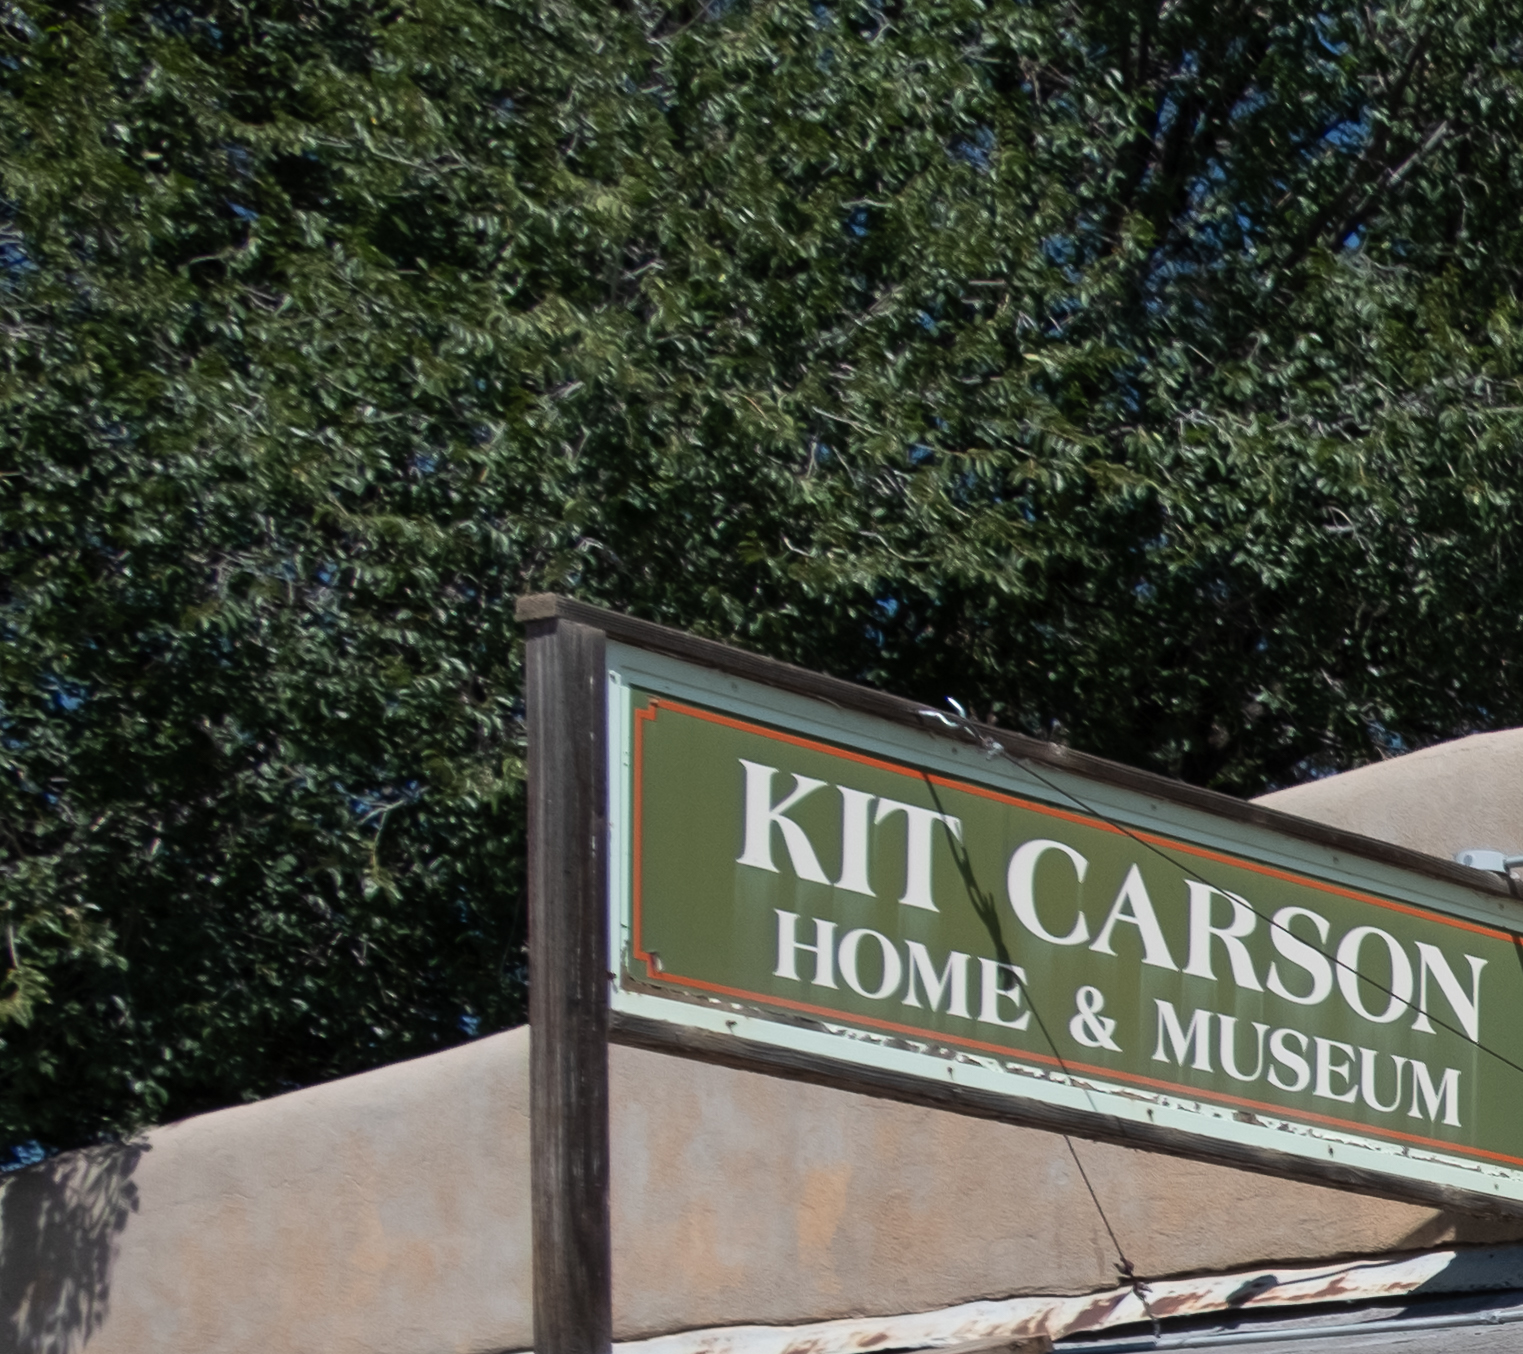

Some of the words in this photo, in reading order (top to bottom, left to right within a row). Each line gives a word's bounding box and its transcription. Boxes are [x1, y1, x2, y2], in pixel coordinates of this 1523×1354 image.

[735, 757, 963, 912] KIT
[1006, 837, 1489, 1041] CARSON
[771, 906, 1032, 1032] HOME
[1068, 984, 1122, 1053] &
[1151, 998, 1463, 1128] MUSEUM
